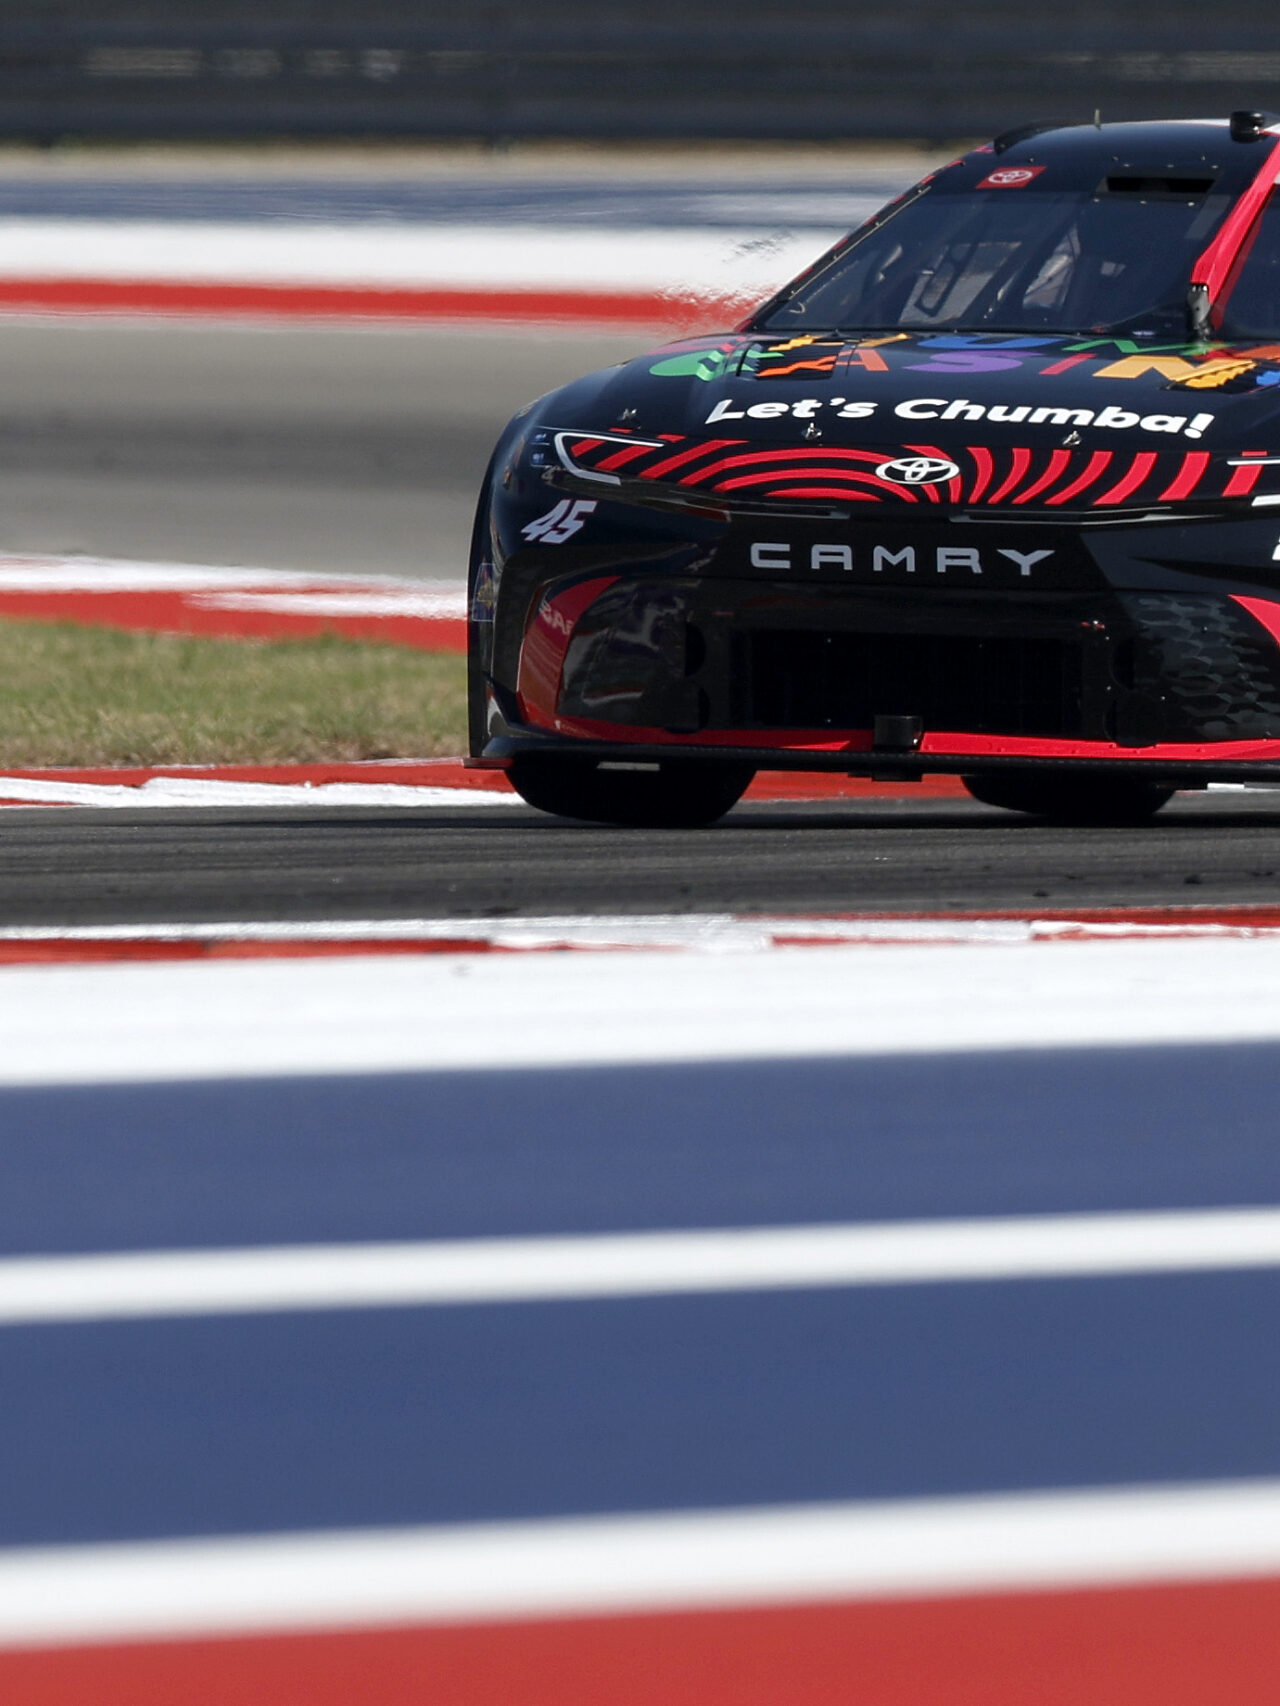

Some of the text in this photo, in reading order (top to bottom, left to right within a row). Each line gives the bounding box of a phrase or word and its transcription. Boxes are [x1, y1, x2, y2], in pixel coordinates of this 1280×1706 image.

[705, 397, 1215, 439] Let's Chumba!
[520, 499, 599, 545] 45
[750, 541, 1055, 576] CAMRY
